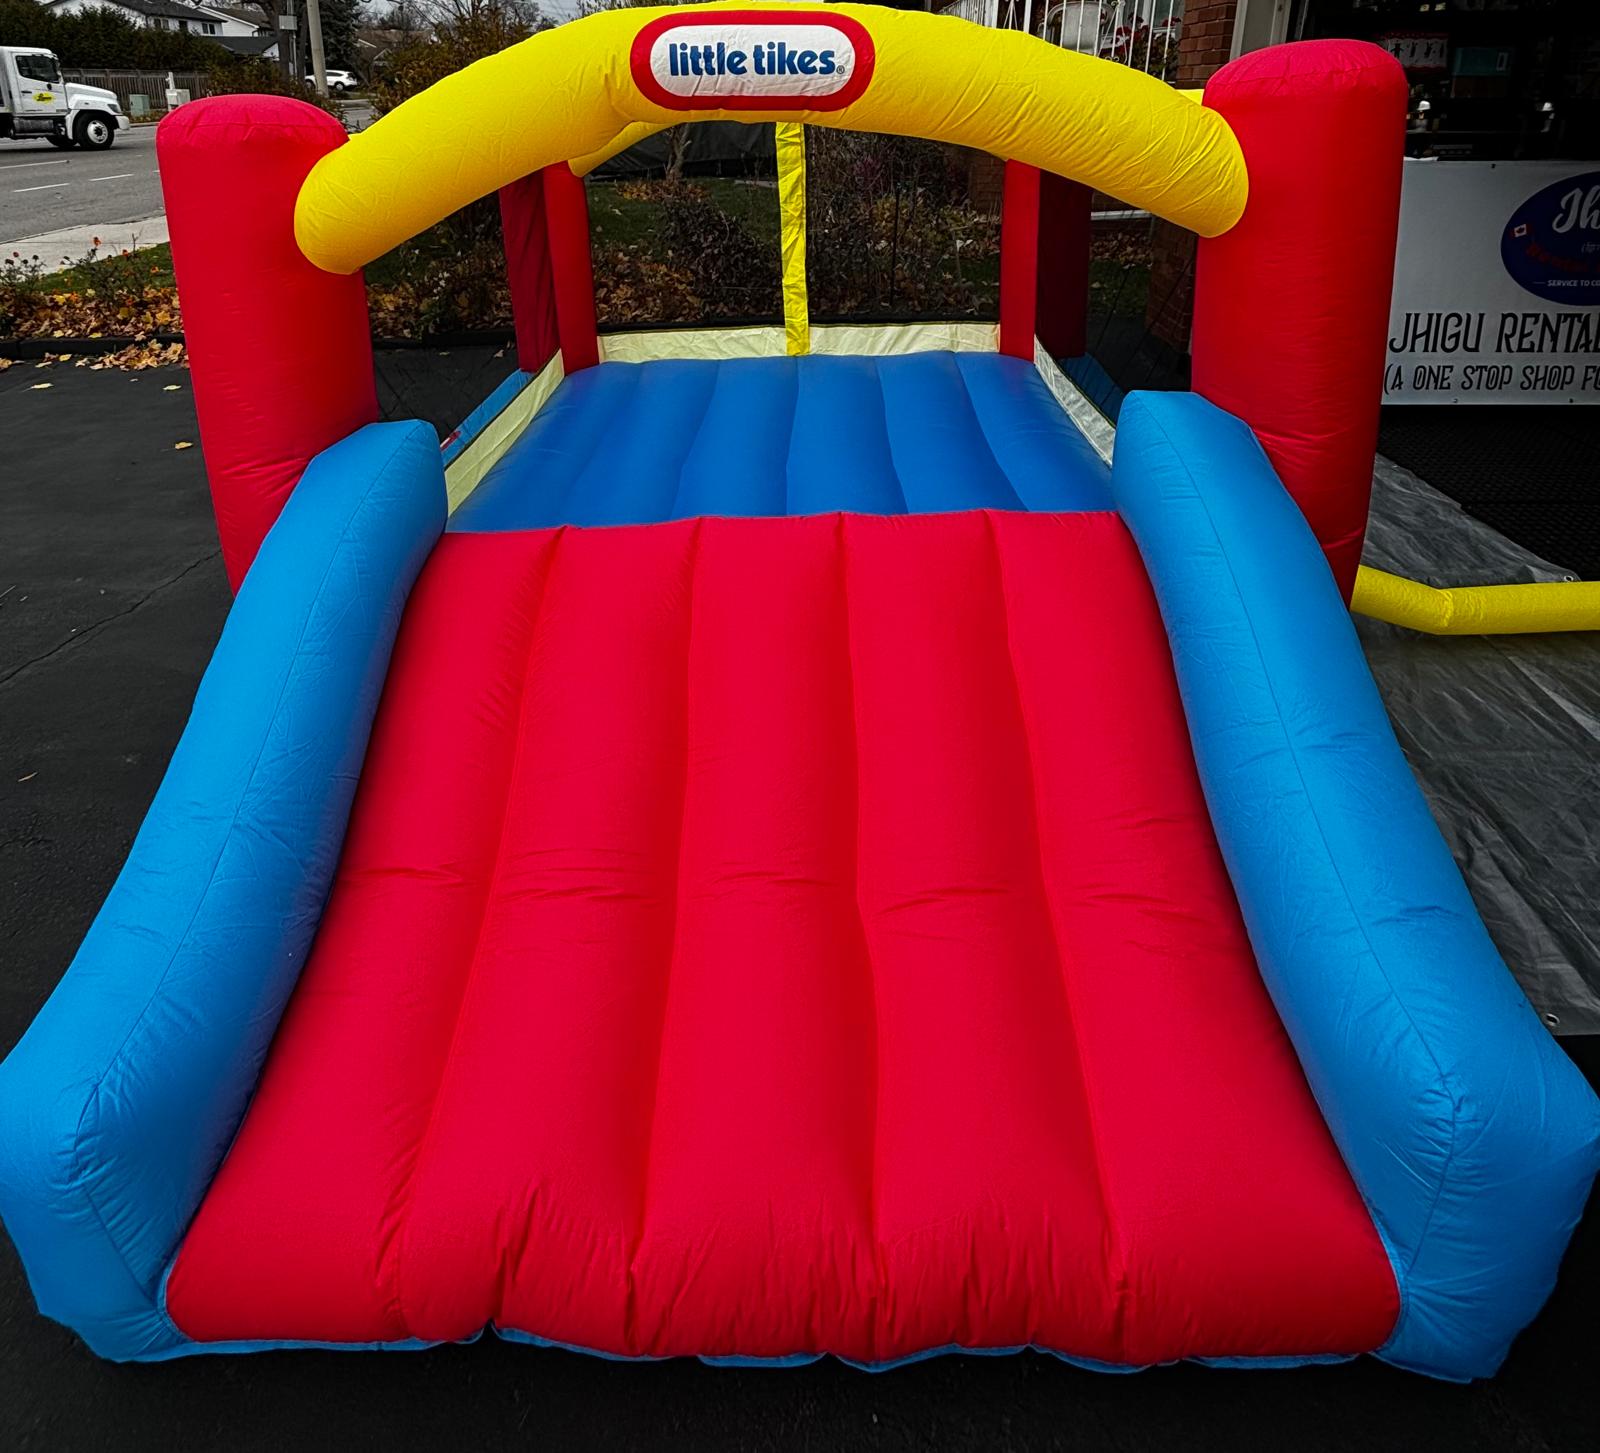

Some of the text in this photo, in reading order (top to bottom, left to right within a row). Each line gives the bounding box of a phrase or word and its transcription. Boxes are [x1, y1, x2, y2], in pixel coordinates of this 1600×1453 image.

[669, 42, 747, 76] little
[1546, 279, 1579, 287] SERVICE
[1580, 279, 1590, 287] TO
[1389, 312, 1485, 354] JHIGU
[1384, 363, 1404, 395] (A
[1413, 365, 1454, 391] ONE
[1461, 365, 1513, 391] STOP
[1520, 365, 1575, 391] SHOP
